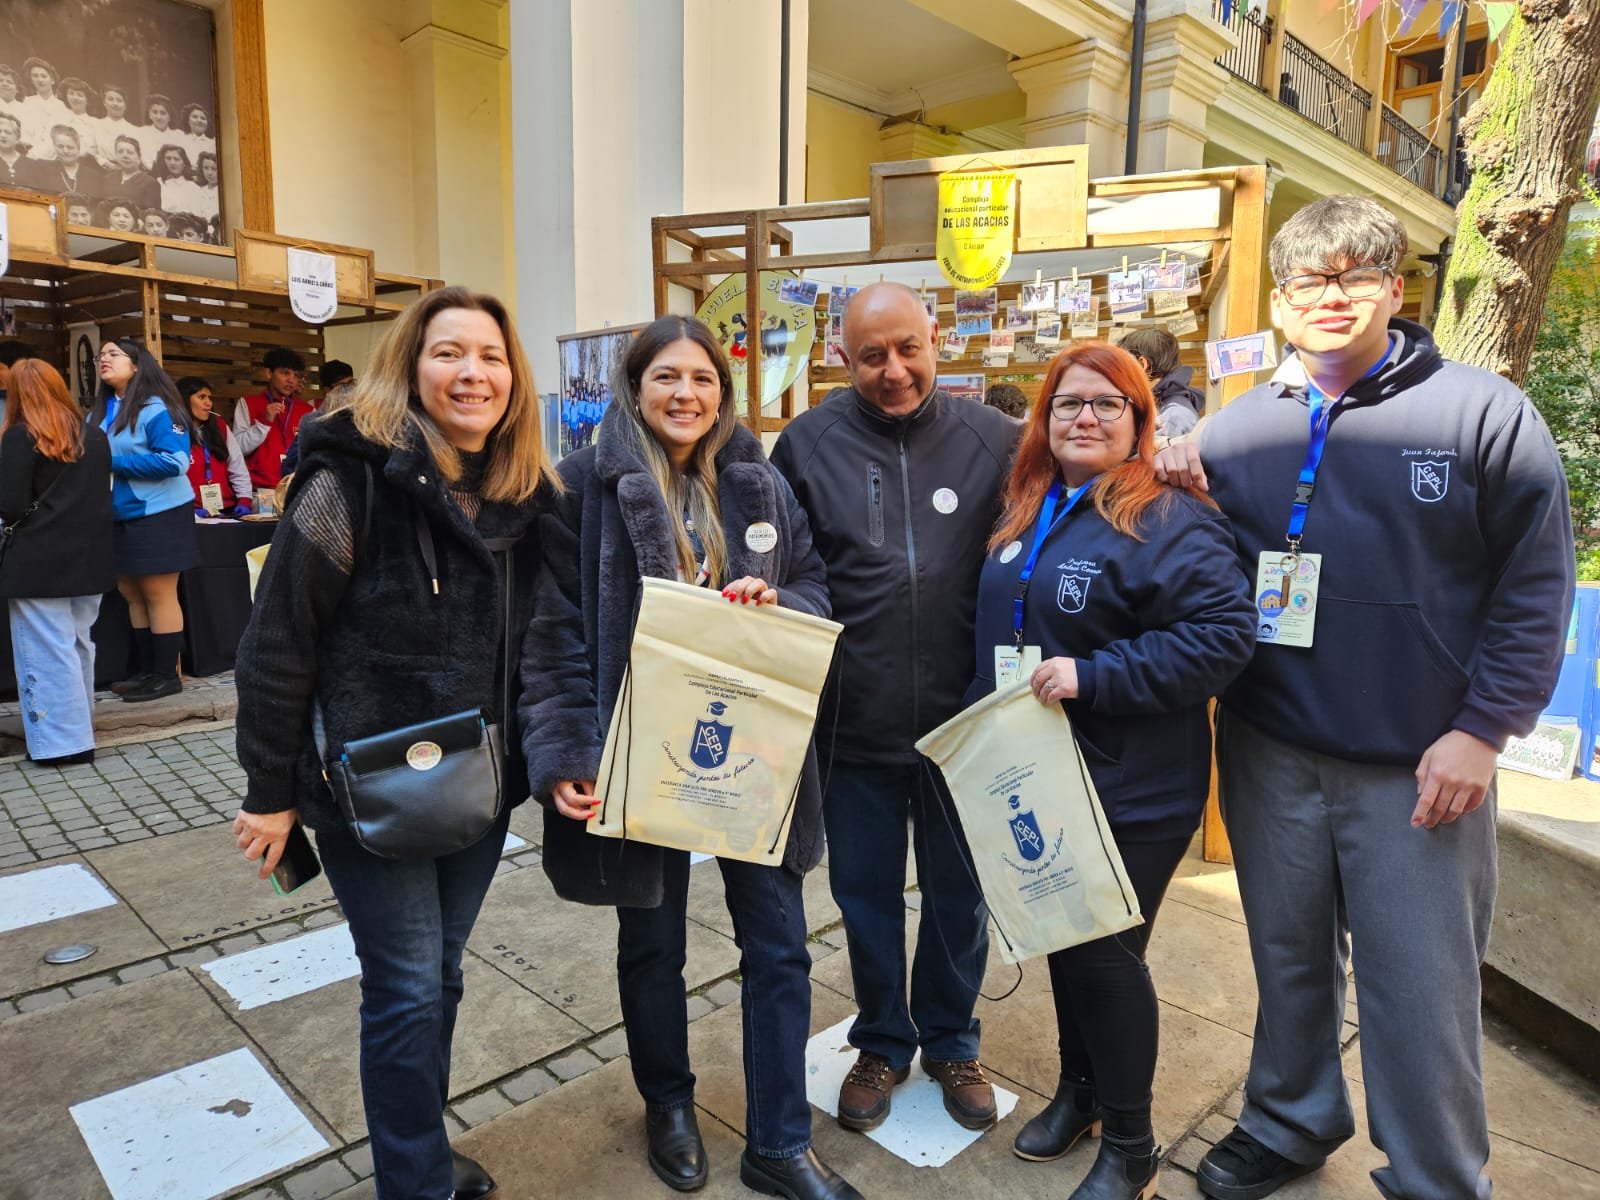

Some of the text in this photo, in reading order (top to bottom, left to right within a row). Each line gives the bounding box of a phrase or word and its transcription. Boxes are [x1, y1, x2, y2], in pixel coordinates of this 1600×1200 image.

[944, 204, 1009, 214] educacional particular
[963, 195, 989, 204] Complejo
[943, 215, 1009, 229] DE LAS ACACIAS
[1401, 448, 1423, 457] Juan
[1423, 466, 1443, 489] CEPL
[1069, 579, 1082, 602] CEPL
[705, 726, 724, 762] CEPL
[733, 757, 755, 779] futuro
[1017, 820, 1040, 849] CEPL
[182, 895, 339, 942] MATUCAN
